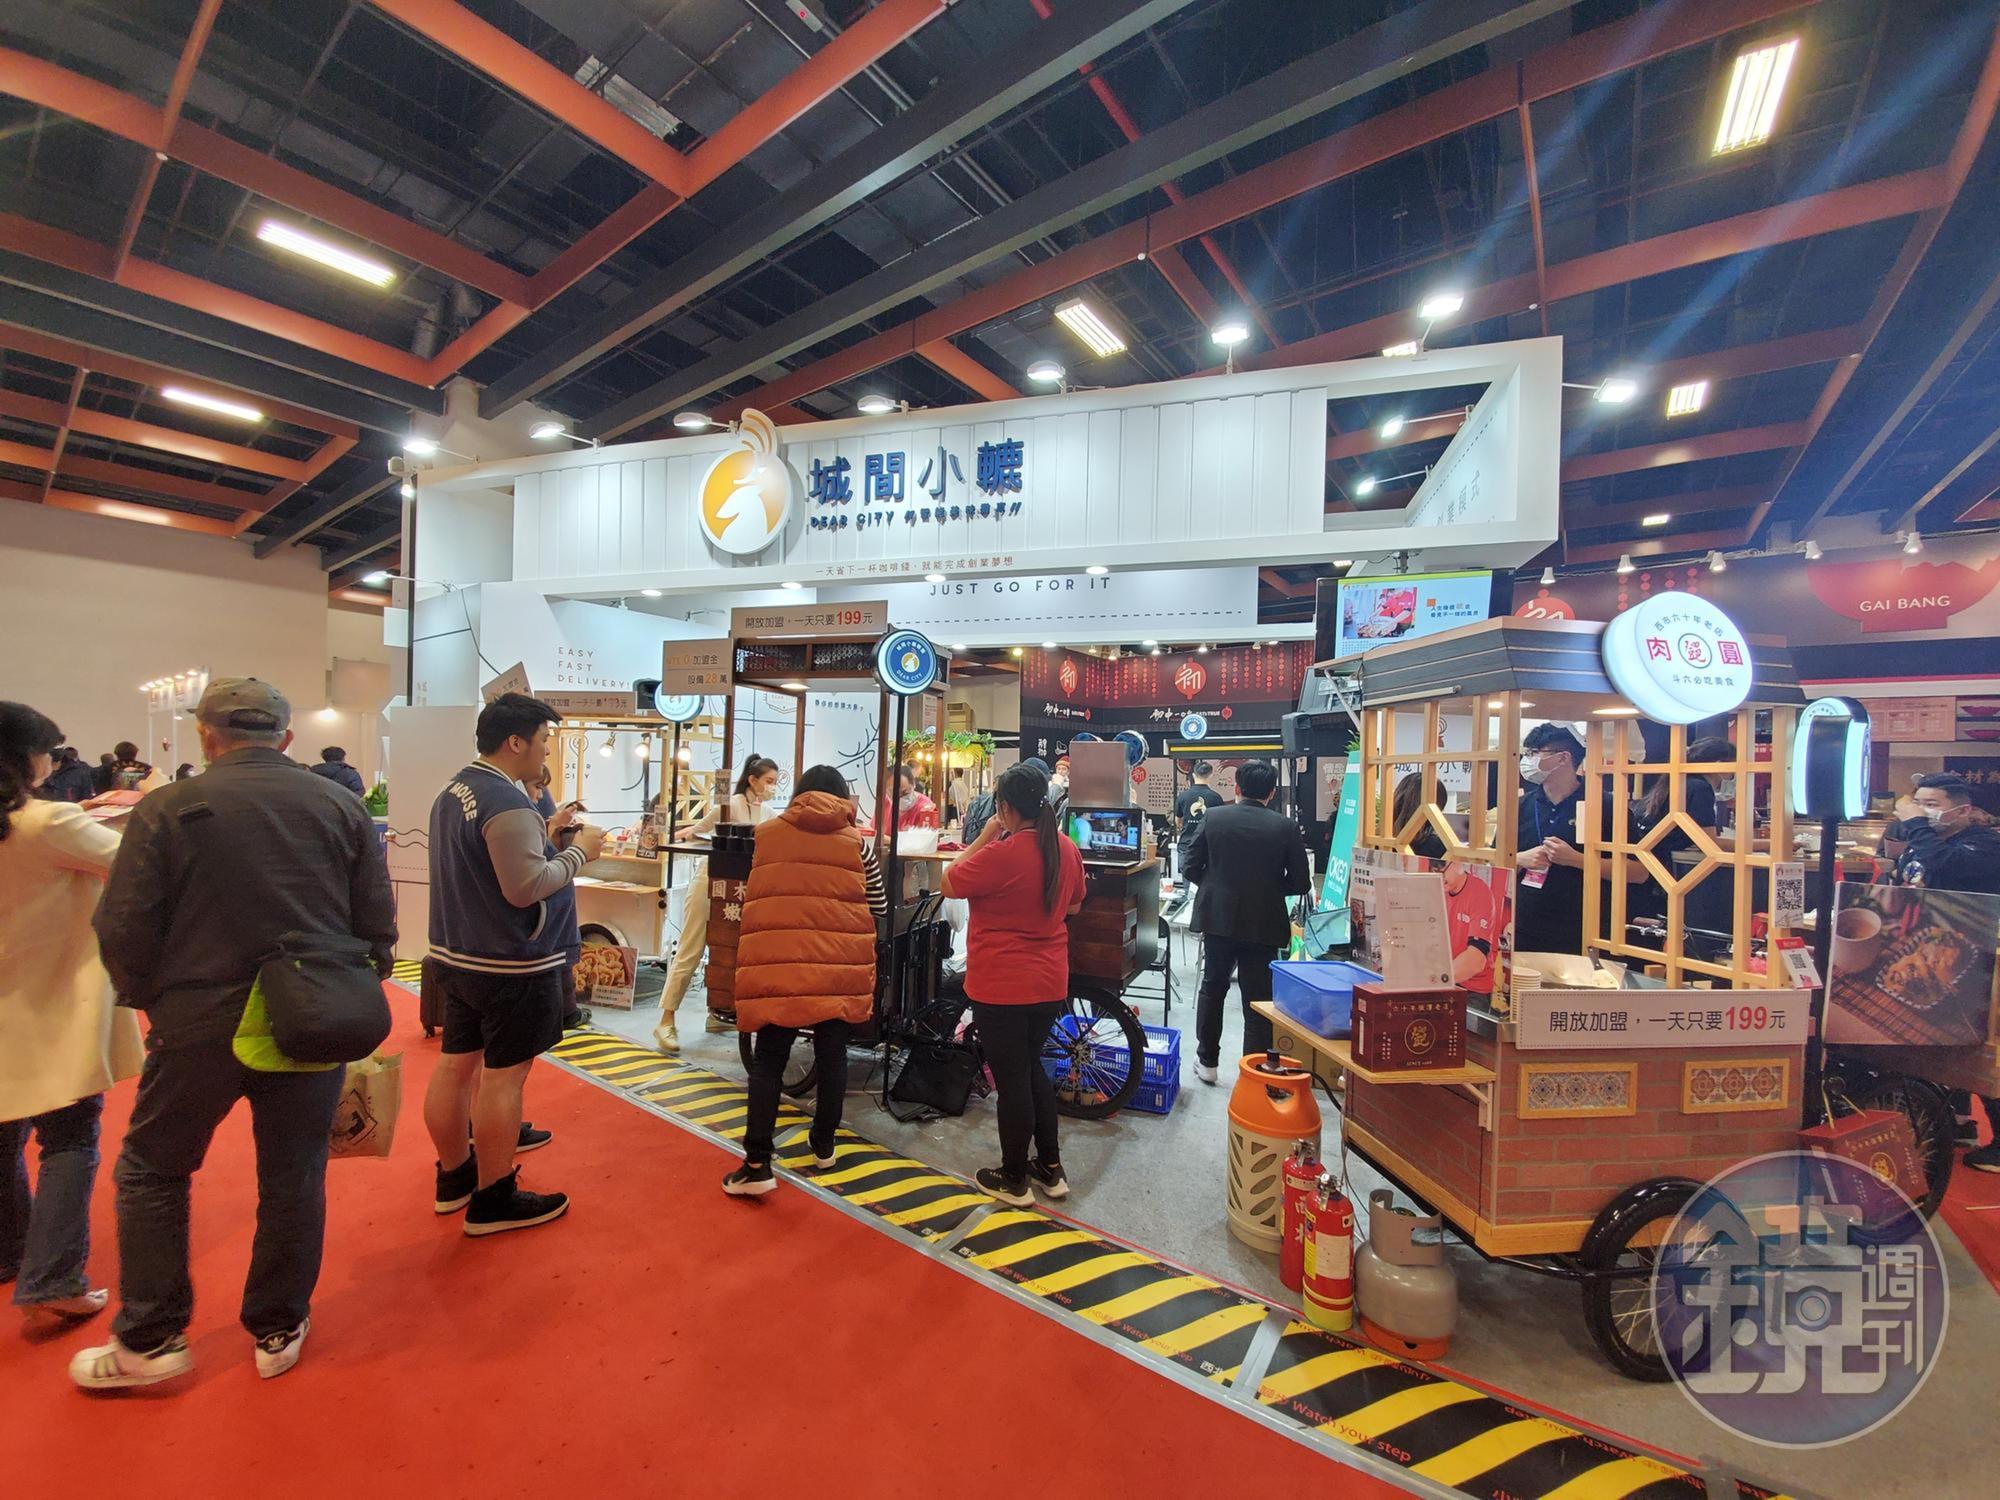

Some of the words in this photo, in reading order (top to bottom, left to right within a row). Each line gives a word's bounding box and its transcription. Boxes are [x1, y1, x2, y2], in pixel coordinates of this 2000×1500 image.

[811, 514, 848, 529] DEAR
[856, 510, 894, 528] CITY
[930, 582, 979, 597] JUST
[993, 581, 1020, 594] GO
[1035, 578, 1075, 592] FOR
[1090, 576, 1111, 590] IT
[1860, 599, 1890, 613] GAI
[1897, 595, 1950, 609] BANG
[557, 646, 595, 659] EASY
[1646, 636, 1673, 662] 肉
[1717, 640, 1744, 666] 圓
[557, 660, 594, 672] FAST
[1549, 1005, 1787, 1033] 開放加盟，一天只要199元
[1122, 1323, 1150, 1340] Watch
[1292, 1399, 1337, 1428] Watch
[1339, 1424, 1376, 1445] your
[1376, 1440, 1412, 1462] step
